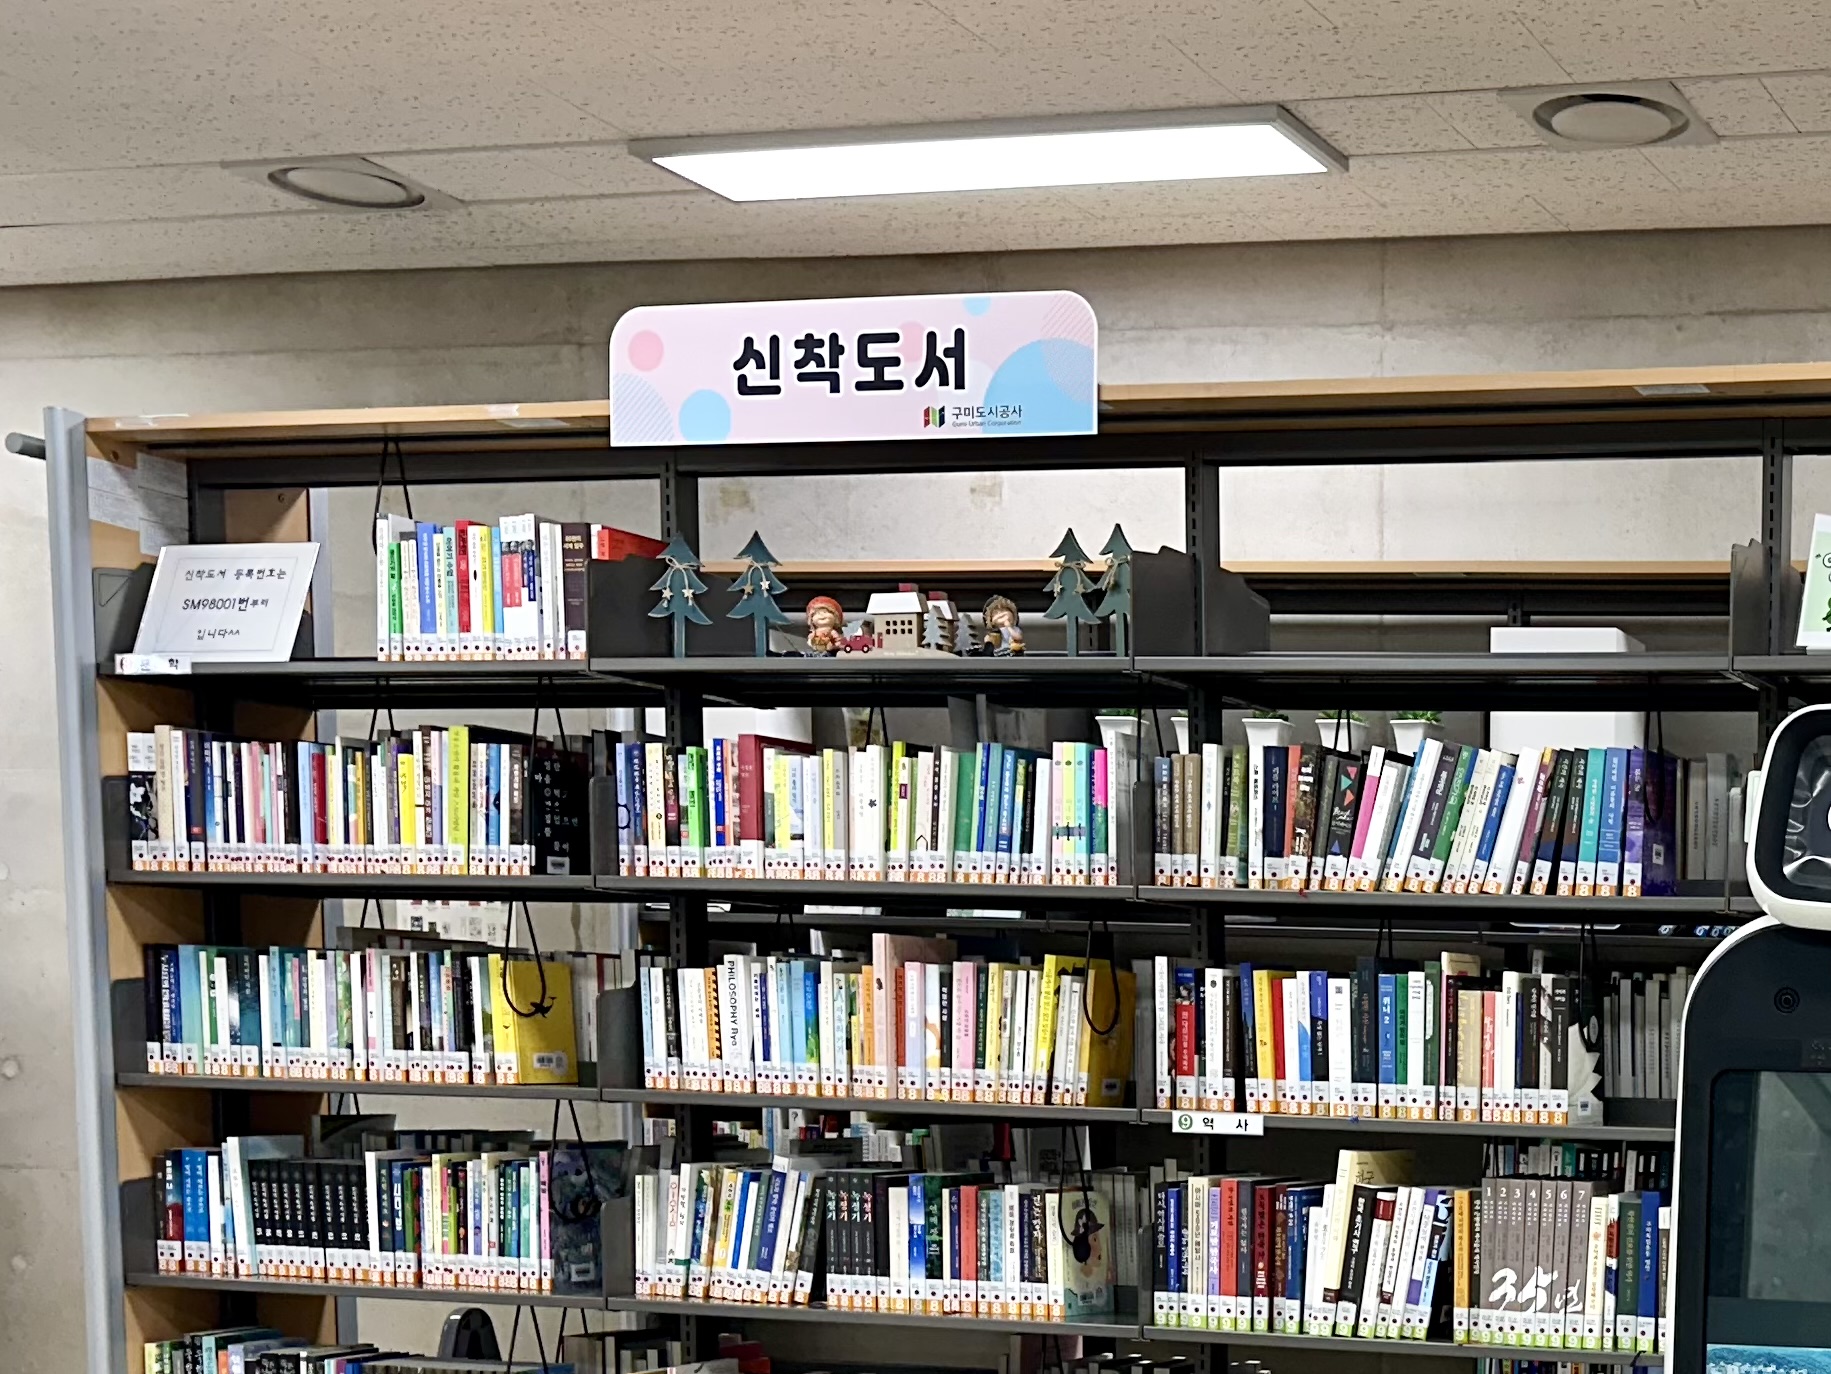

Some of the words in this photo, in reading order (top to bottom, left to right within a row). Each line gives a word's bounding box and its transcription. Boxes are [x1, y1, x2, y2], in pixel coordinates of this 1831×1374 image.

[733, 328, 967, 396] 신착도서
[952, 405, 1022, 419] 구미도시공사
[1192, 1316, 1202, 1327] 9
[1222, 1318, 1232, 1329] 9
